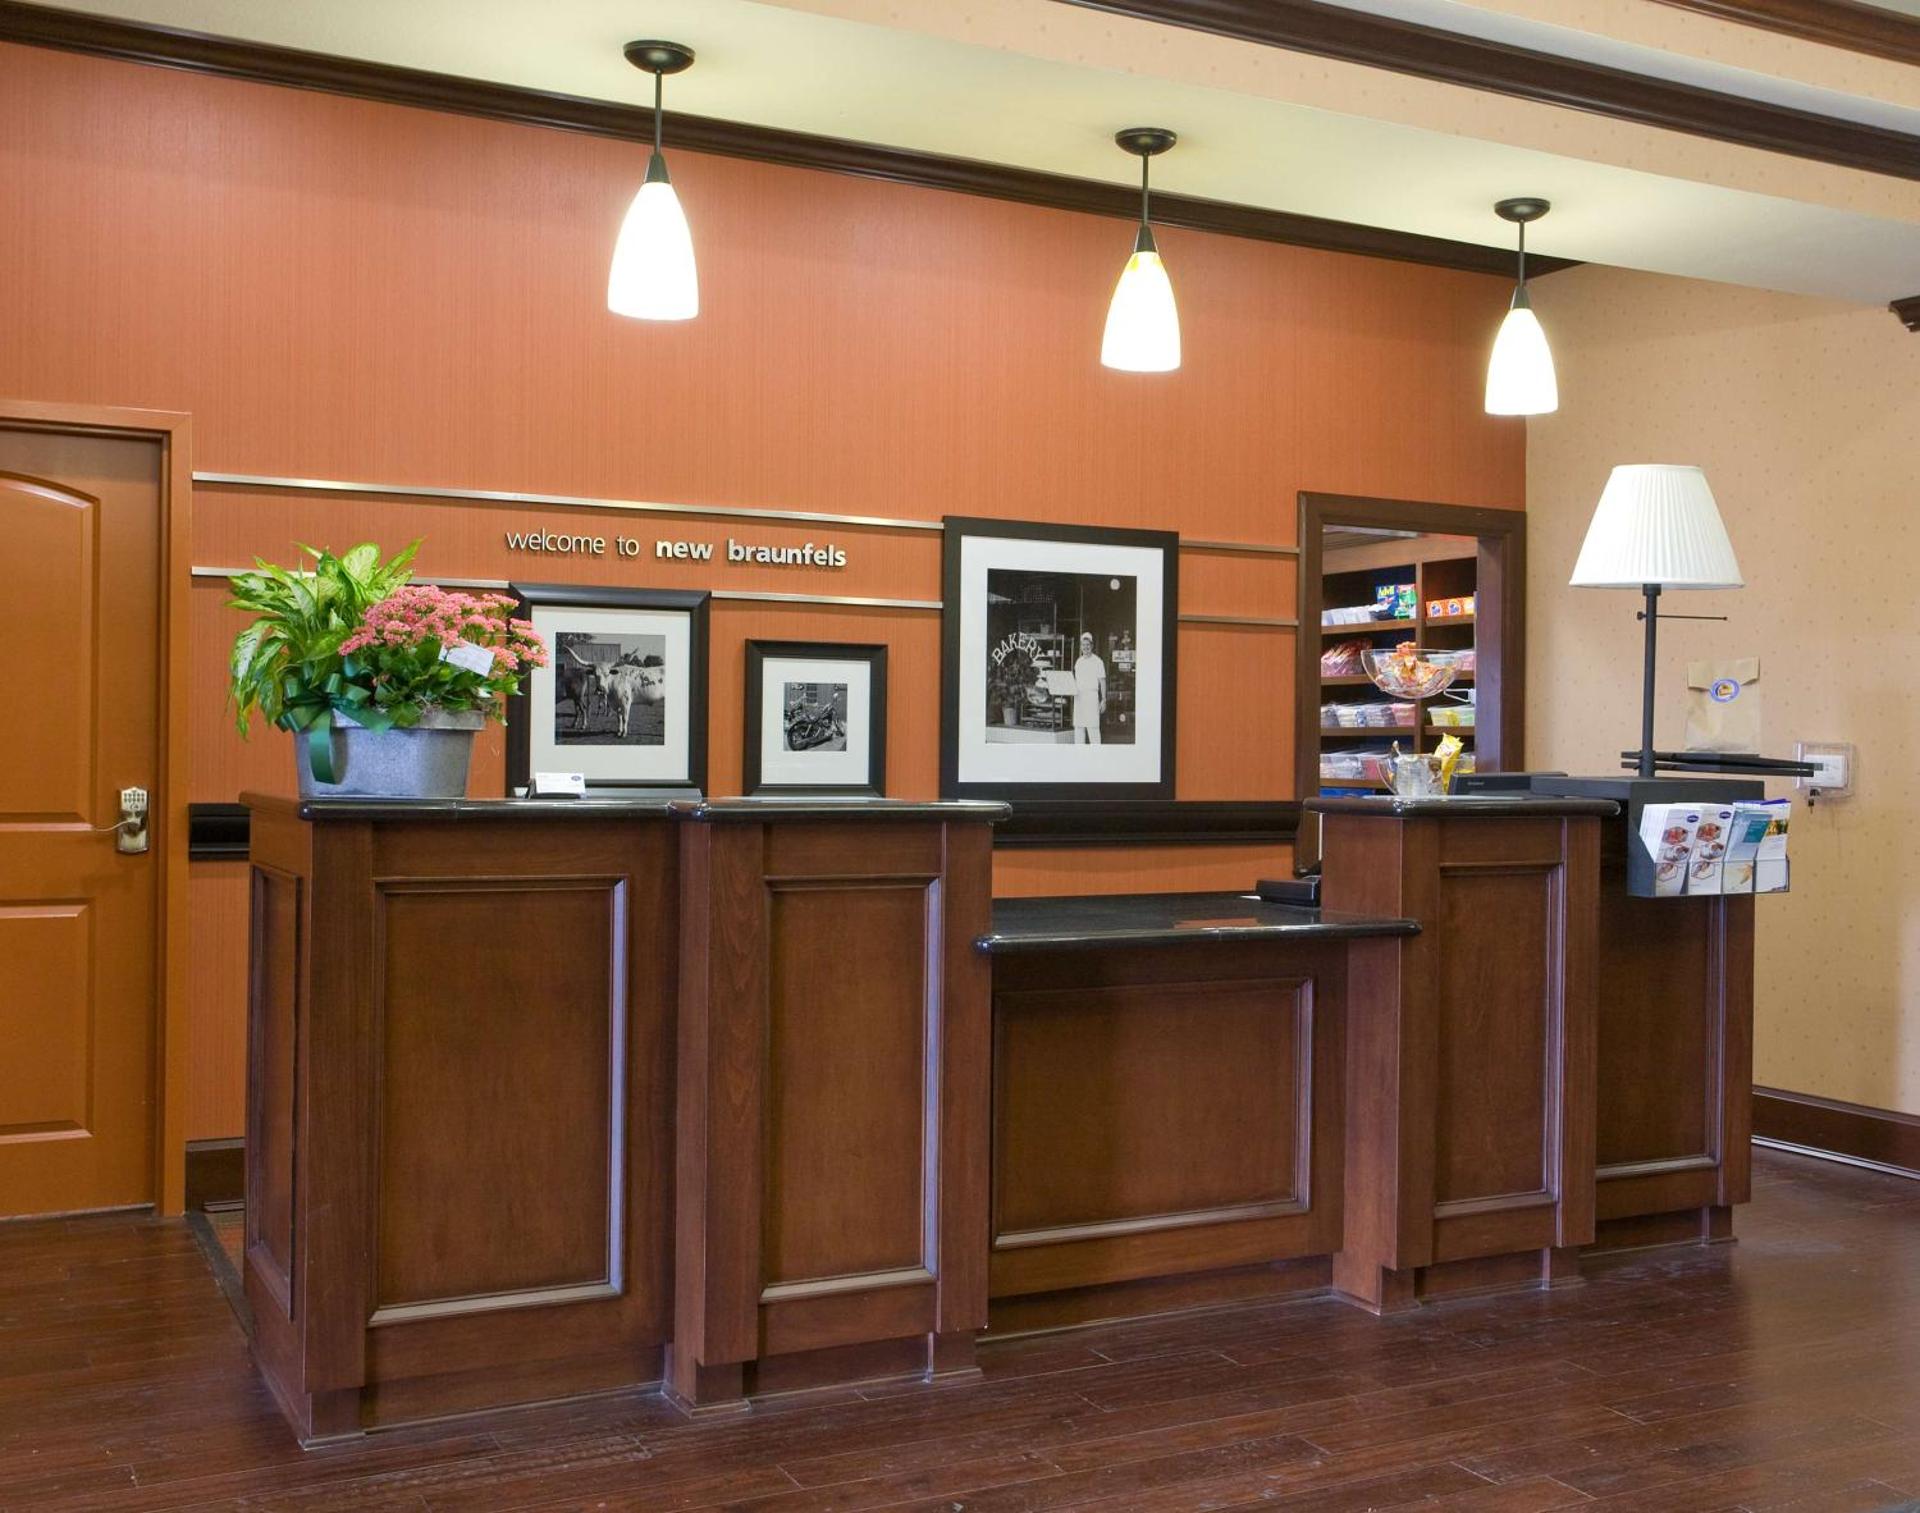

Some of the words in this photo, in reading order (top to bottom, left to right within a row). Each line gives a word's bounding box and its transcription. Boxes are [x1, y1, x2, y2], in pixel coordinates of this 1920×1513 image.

[506, 528, 606, 554] welcome
[616, 536, 640, 556] to
[656, 540, 714, 560] new
[728, 538, 847, 566] braunfels
[991, 631, 1046, 666] BAKERY
